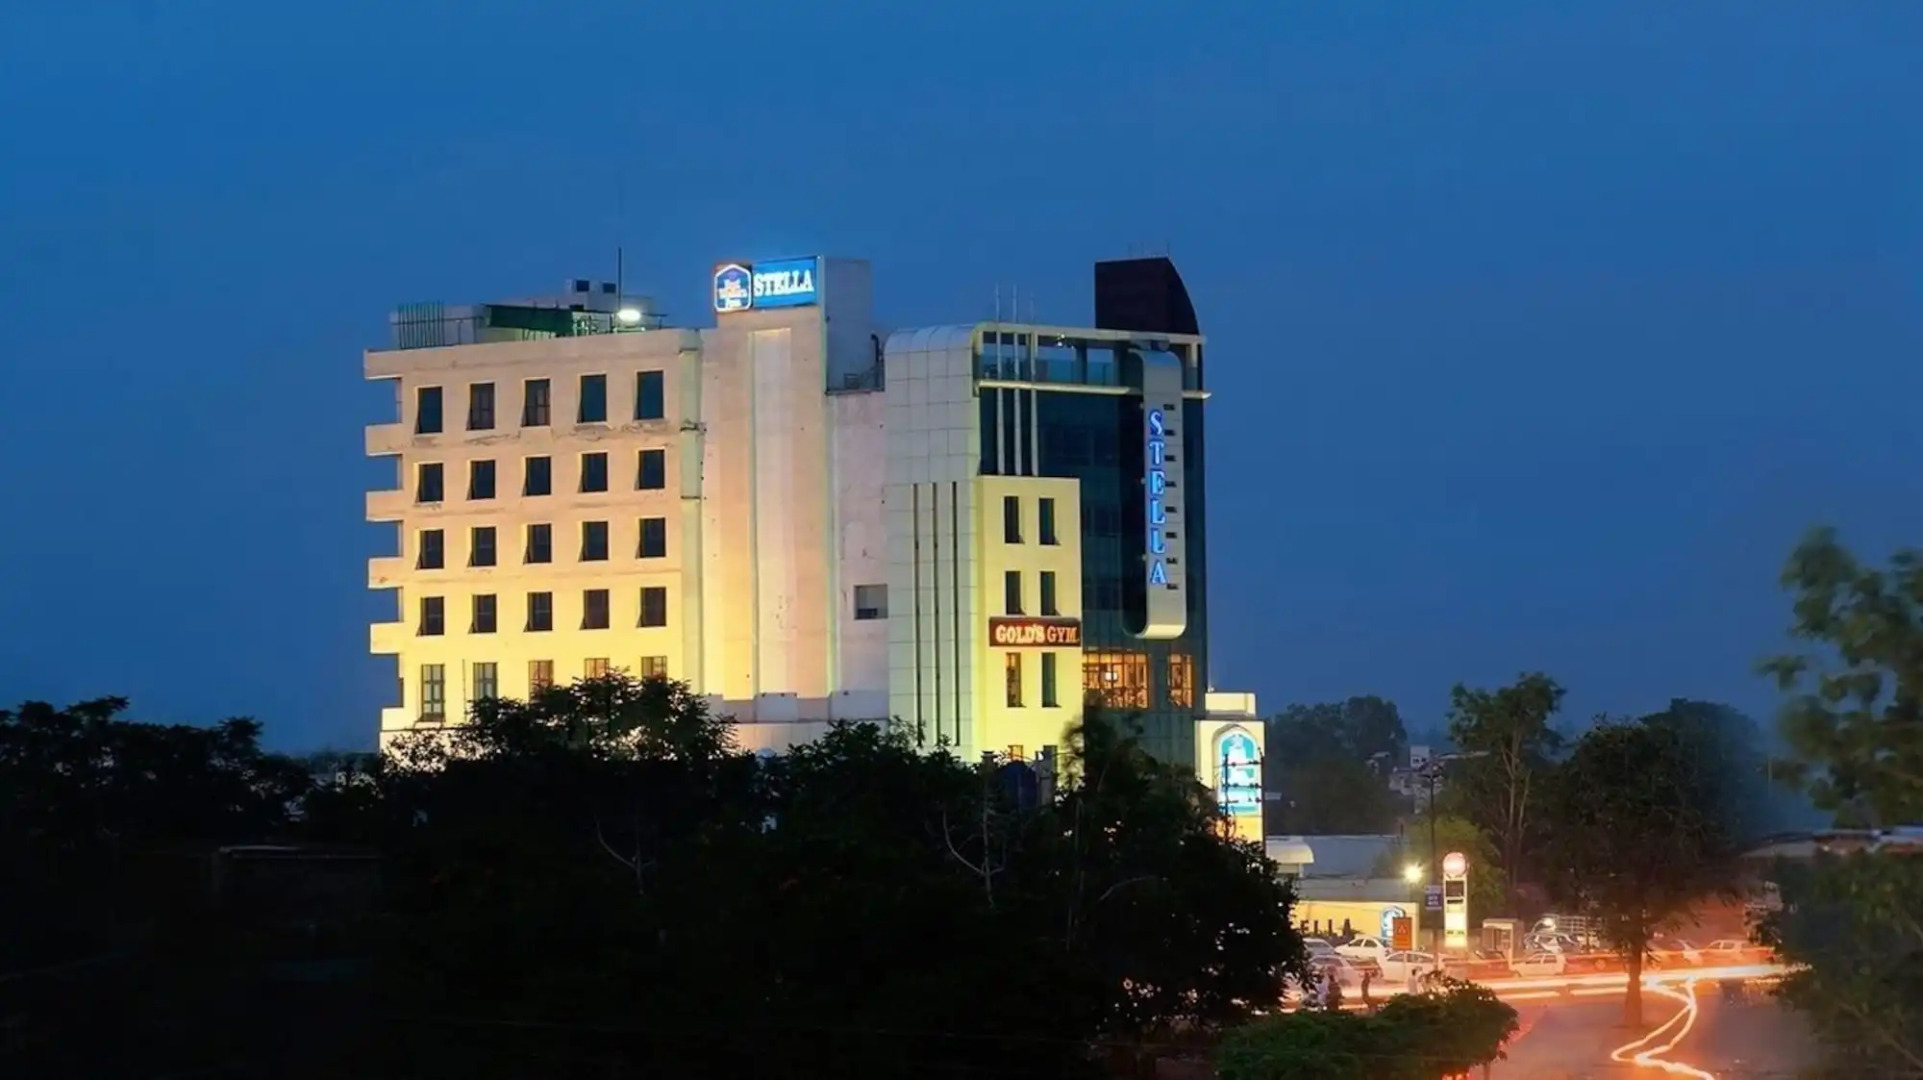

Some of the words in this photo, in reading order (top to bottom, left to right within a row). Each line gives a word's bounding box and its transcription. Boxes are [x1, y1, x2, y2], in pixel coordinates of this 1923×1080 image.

[753, 269, 815, 297] STELLA
[1149, 411, 1167, 585] STELLA
[995, 624, 1046, 644] GOLD'S
